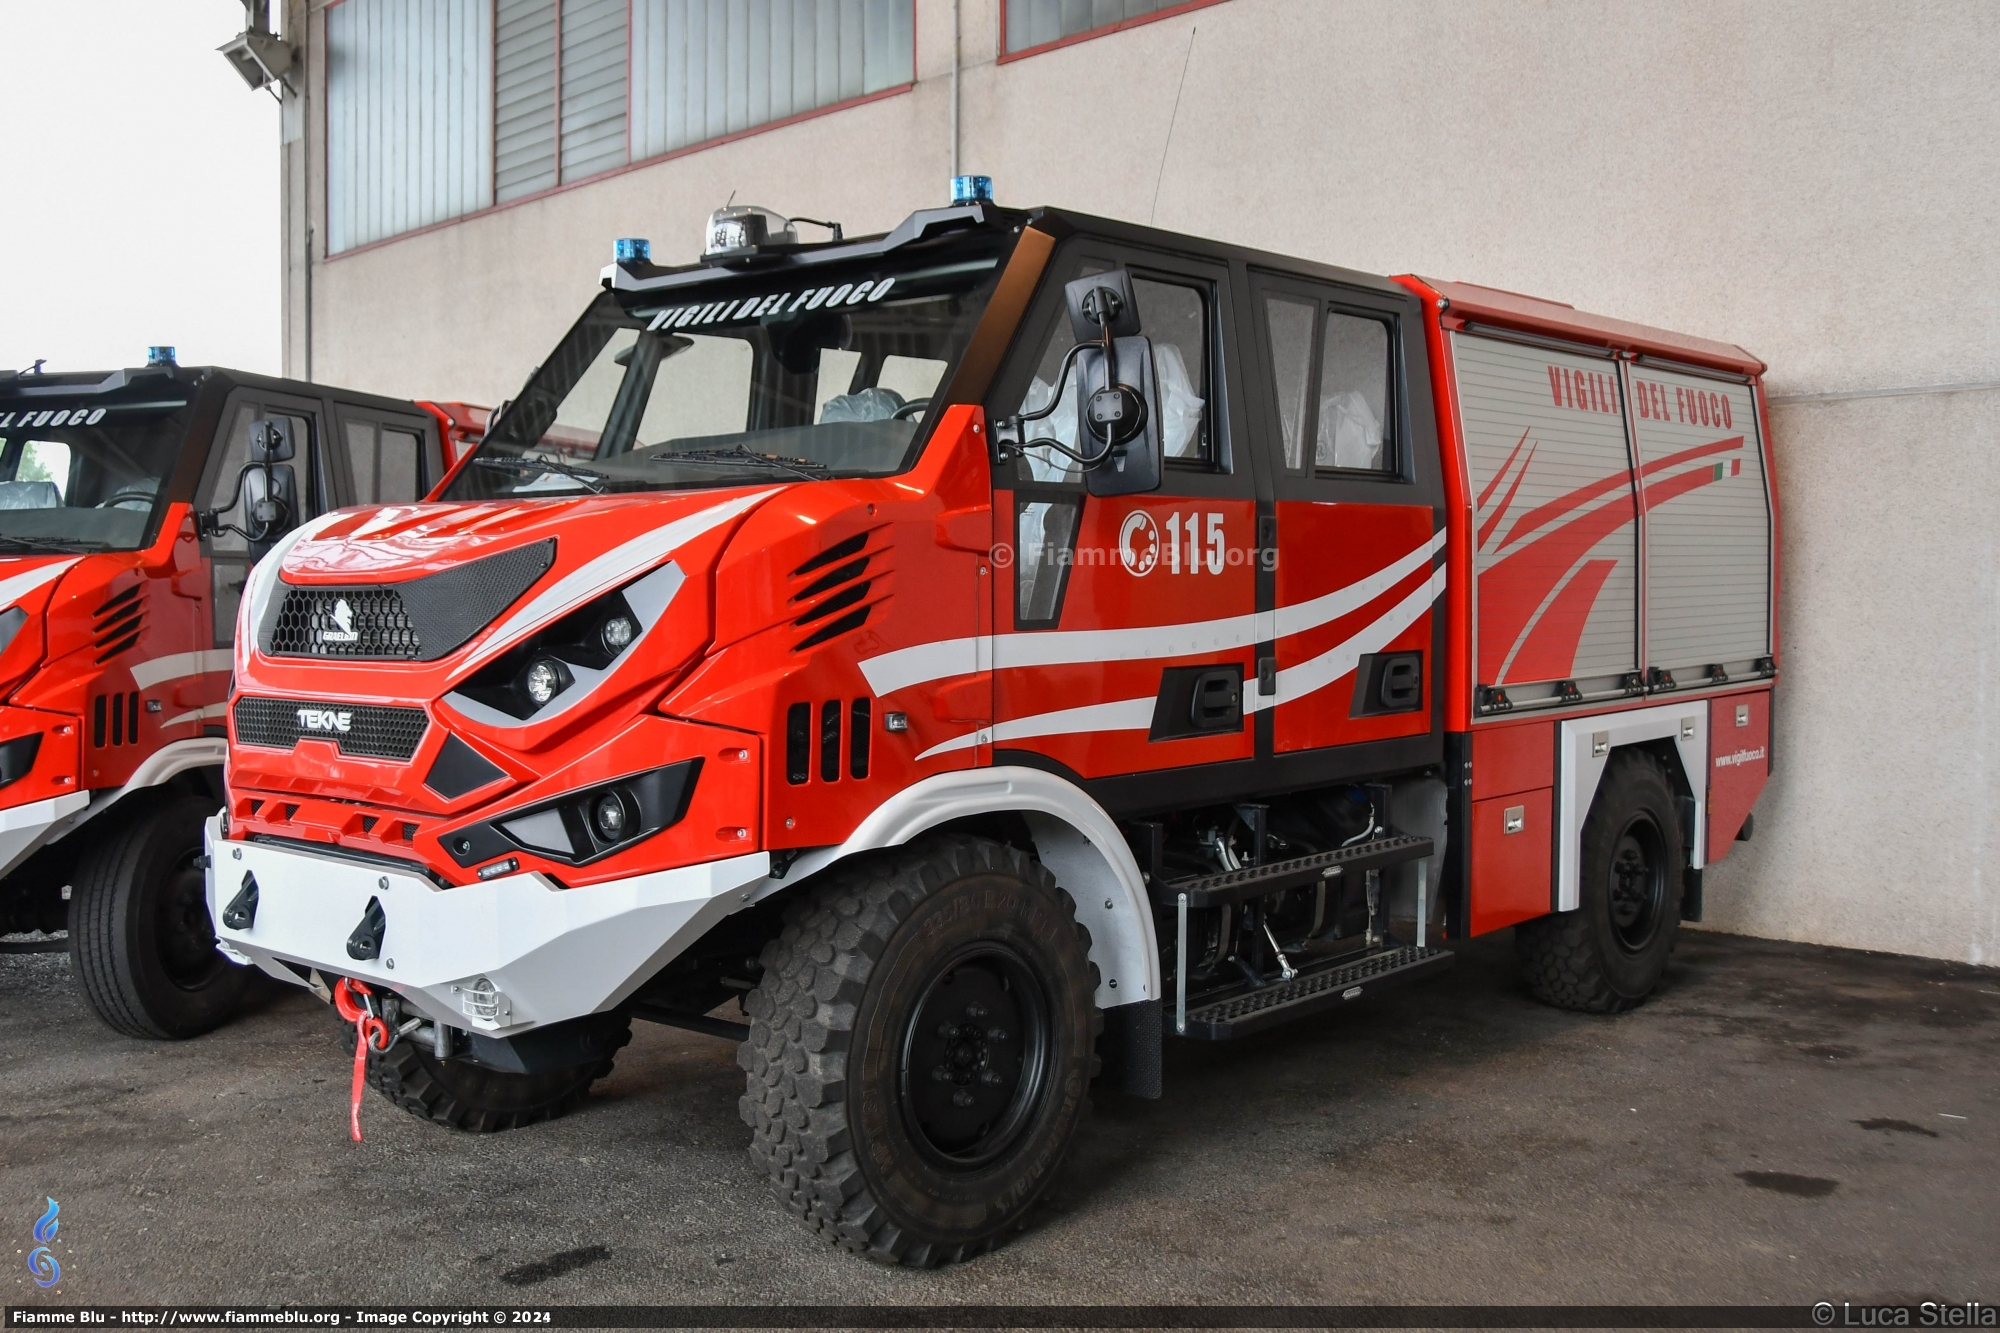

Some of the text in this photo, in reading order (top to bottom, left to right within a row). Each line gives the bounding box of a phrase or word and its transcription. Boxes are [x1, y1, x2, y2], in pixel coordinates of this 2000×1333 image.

[647, 277, 895, 332] VIGILI DEL FUOCO
[16, 408, 107, 428] FUOCO
[1548, 366, 1732, 429] VIGILI DEL FUOCO
[1166, 511, 1225, 575] 115
[297, 709, 353, 732] TEKNE
